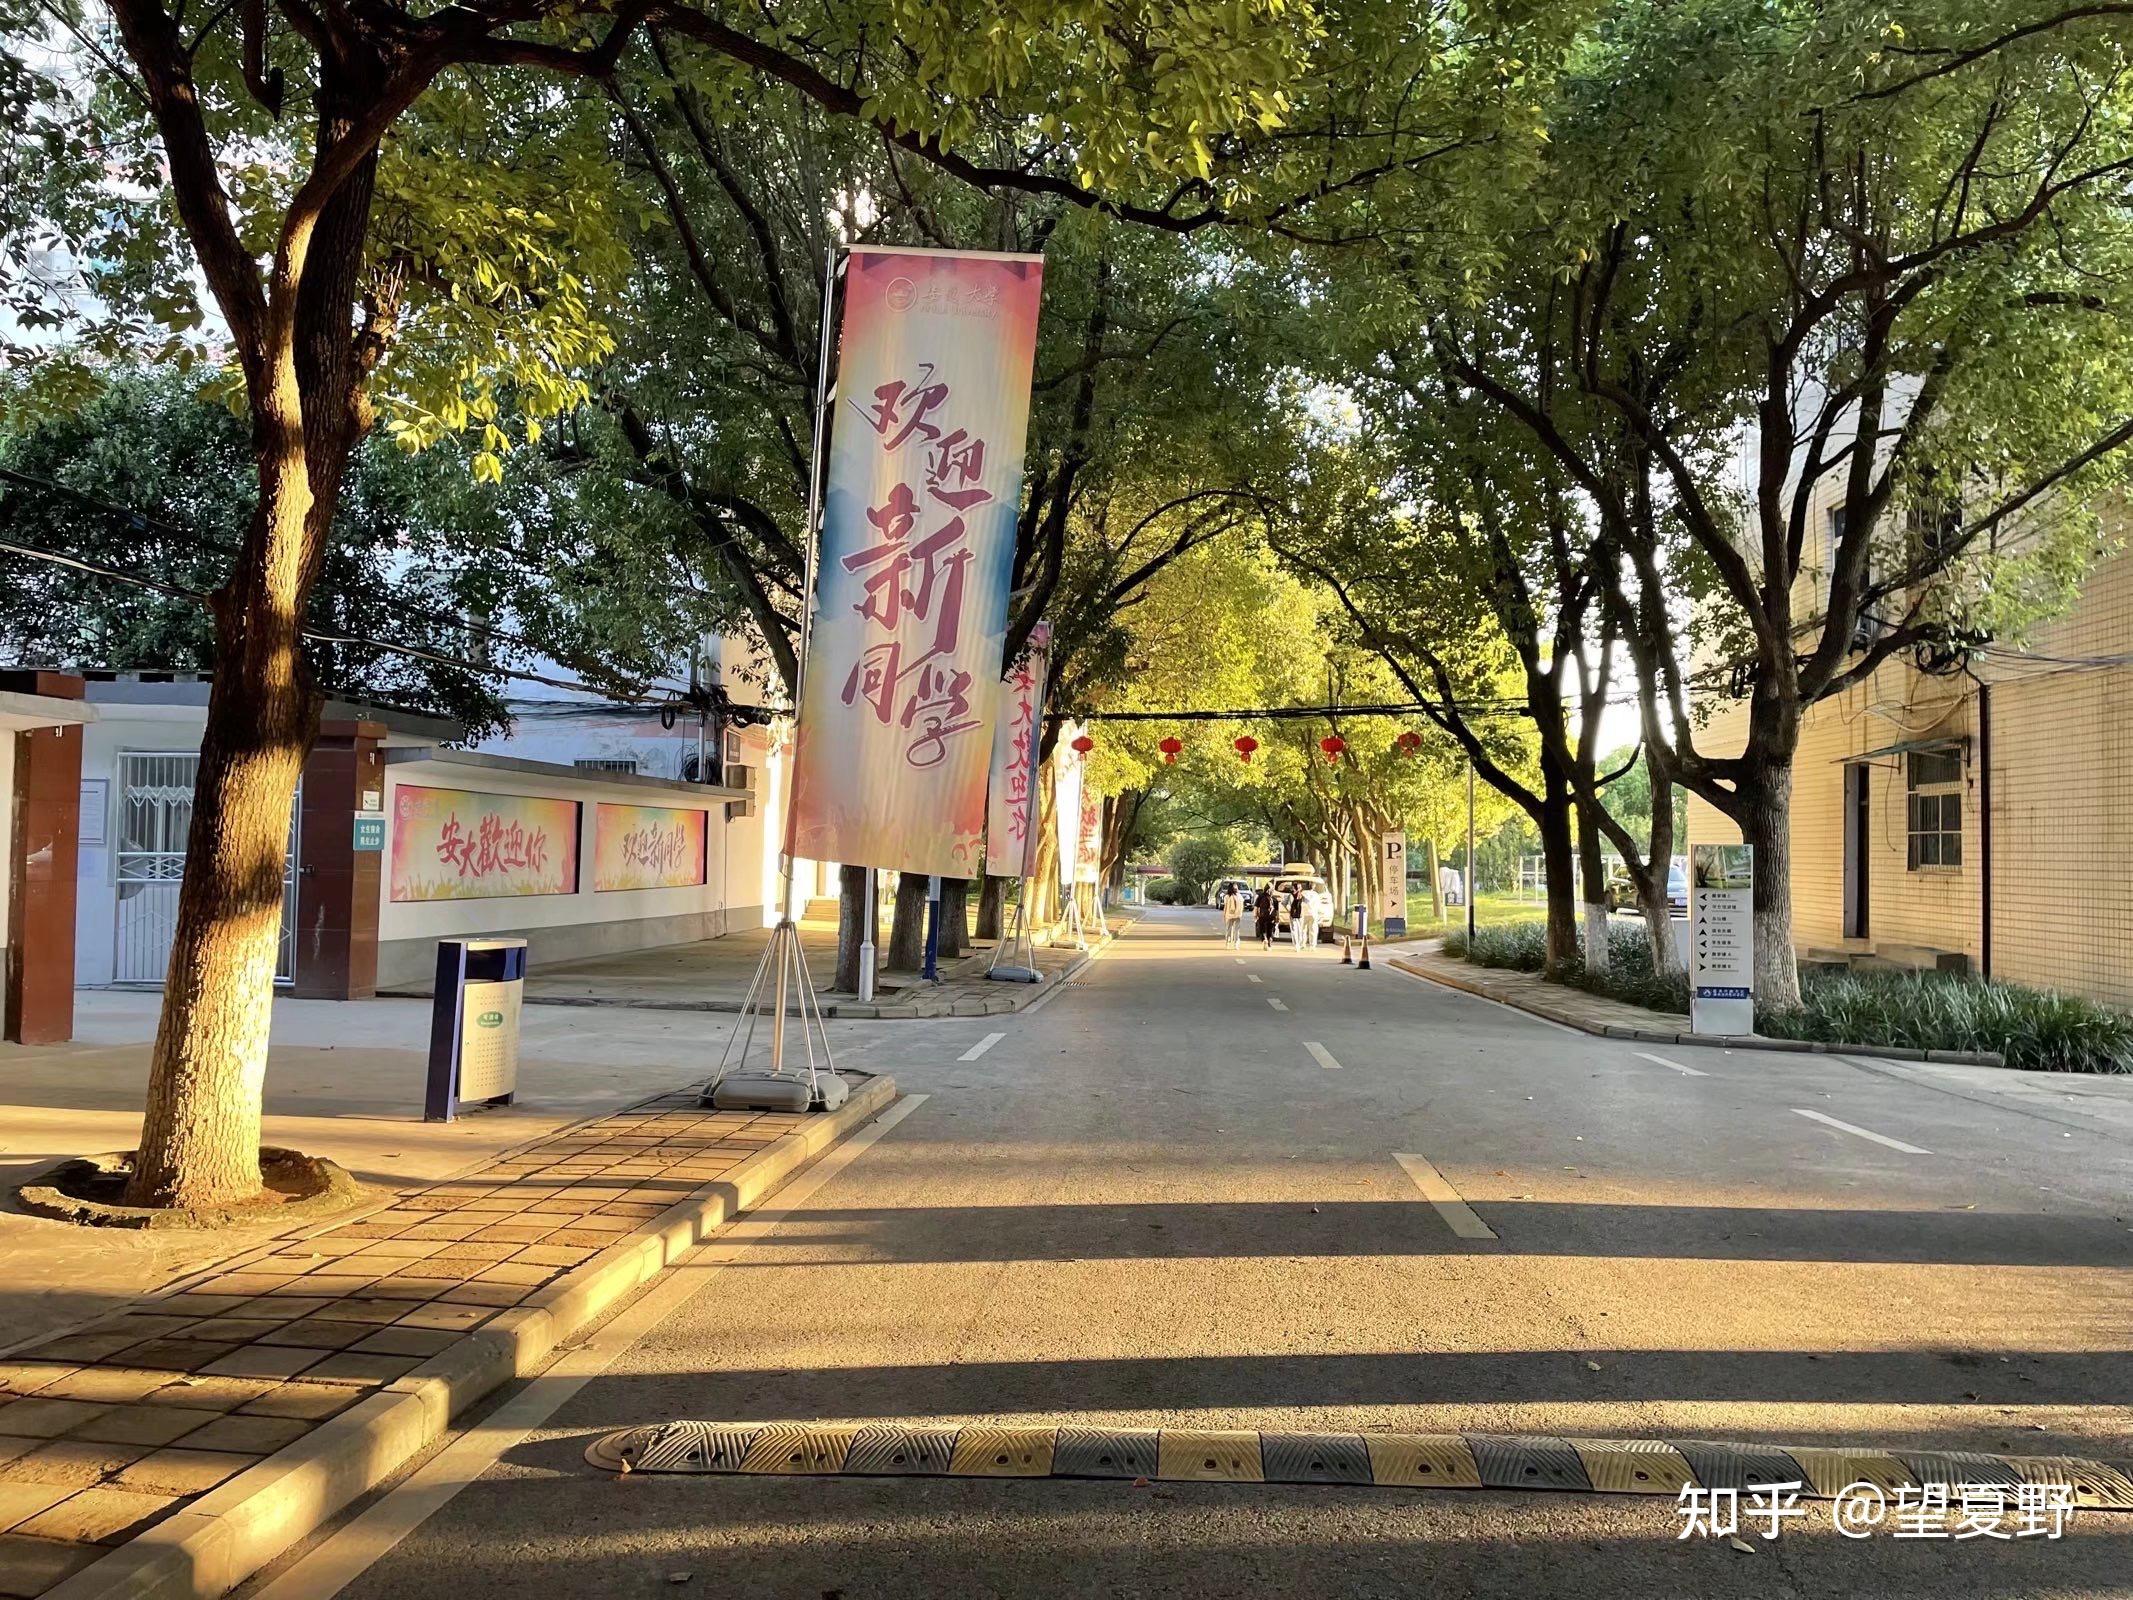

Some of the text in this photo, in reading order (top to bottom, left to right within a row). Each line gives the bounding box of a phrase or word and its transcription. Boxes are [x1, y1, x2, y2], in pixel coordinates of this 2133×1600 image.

[842, 362, 994, 768] 欢迎新同学
[619, 821, 686, 874] 欢迎新同学
[1386, 842, 1402, 859] P
[1389, 864, 1399, 896] 停车场
